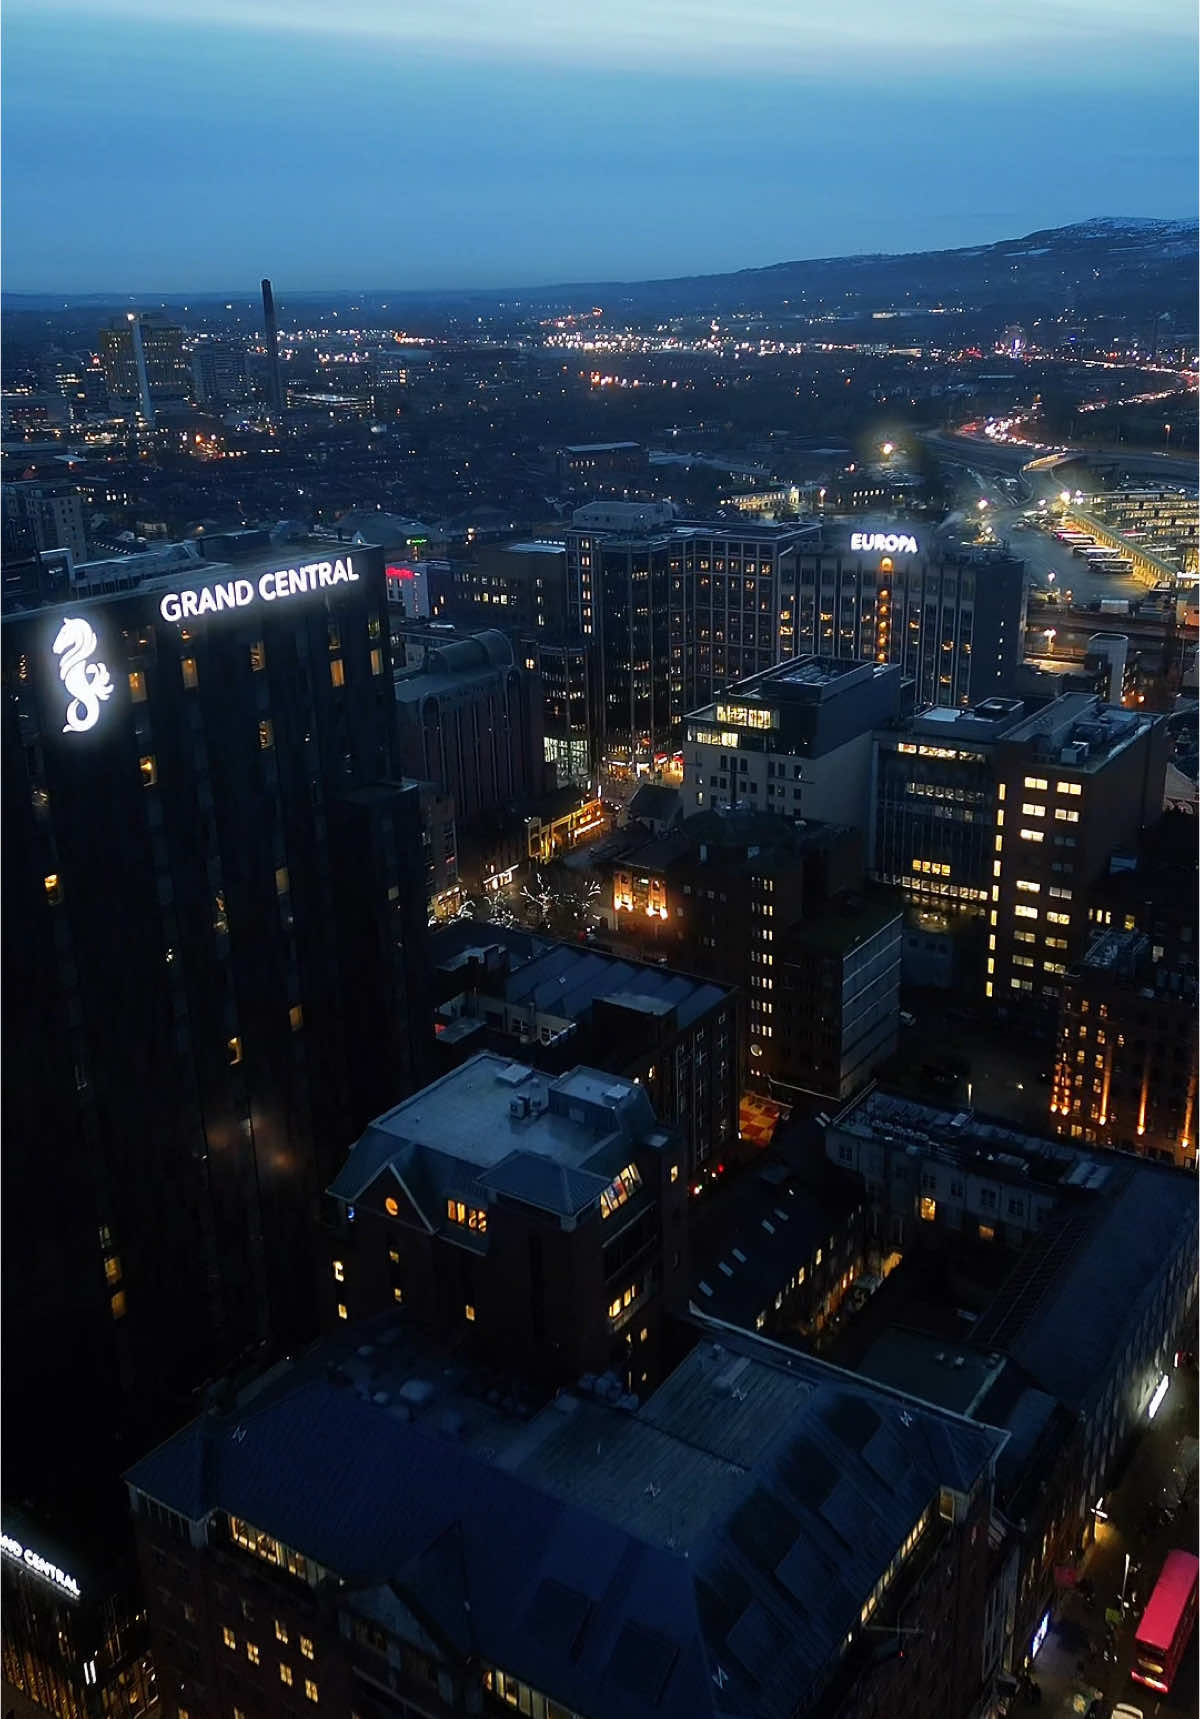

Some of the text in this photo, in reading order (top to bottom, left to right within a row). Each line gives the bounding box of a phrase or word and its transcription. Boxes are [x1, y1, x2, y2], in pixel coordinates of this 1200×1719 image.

[851, 533, 918, 554] EUROPA
[160, 557, 360, 622] GRAND CENTRAL
[24, 1549, 81, 1596] CENTRAL
